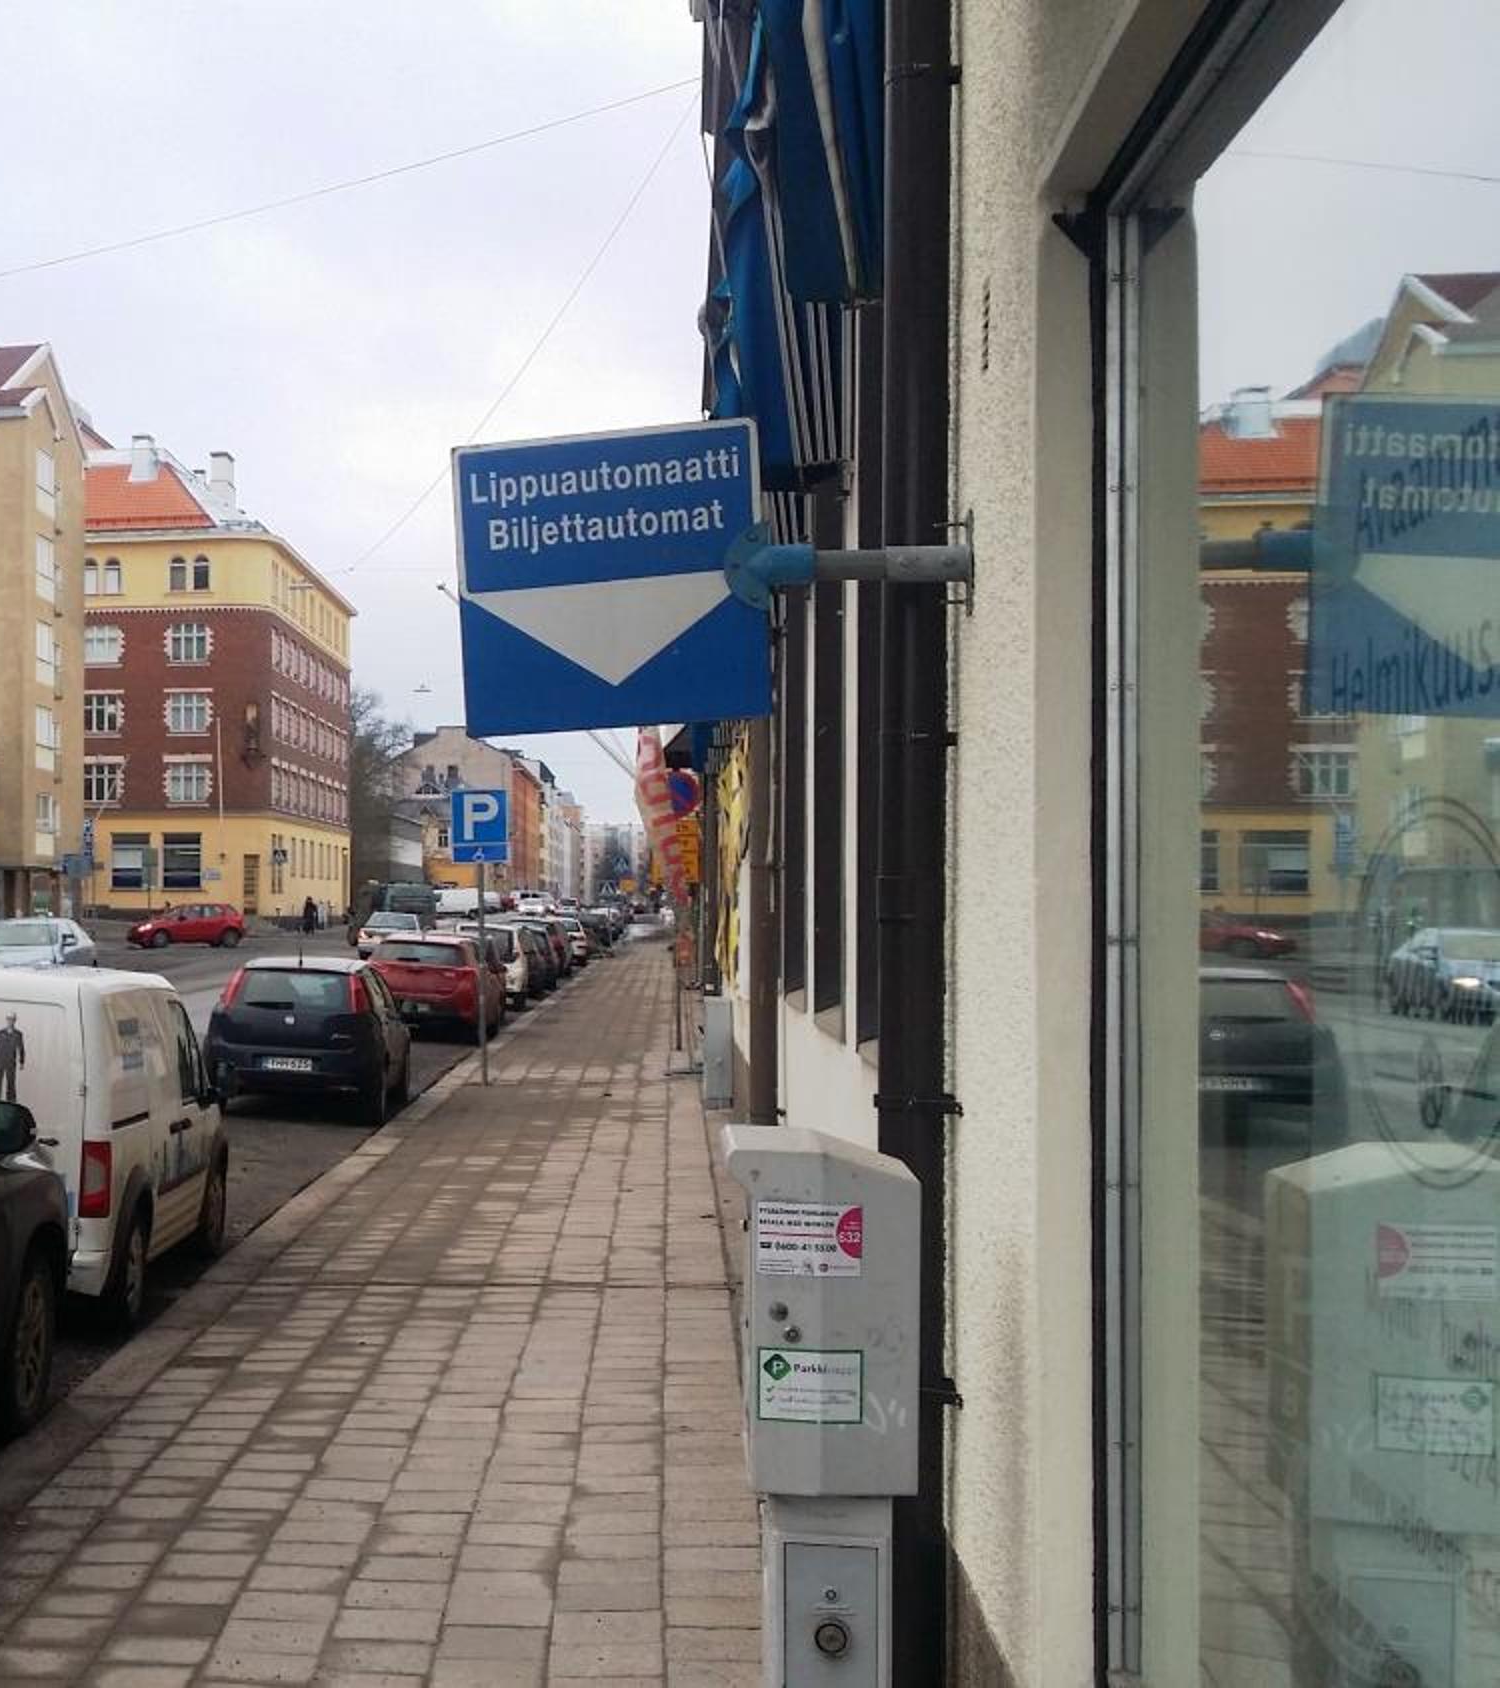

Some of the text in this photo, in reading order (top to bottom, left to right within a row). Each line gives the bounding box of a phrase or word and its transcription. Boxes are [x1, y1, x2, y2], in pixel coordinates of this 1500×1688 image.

[469, 446, 740, 508] Lippuautomaatti
[488, 500, 725, 554] Biljettautomat
[463, 794, 498, 840] P
